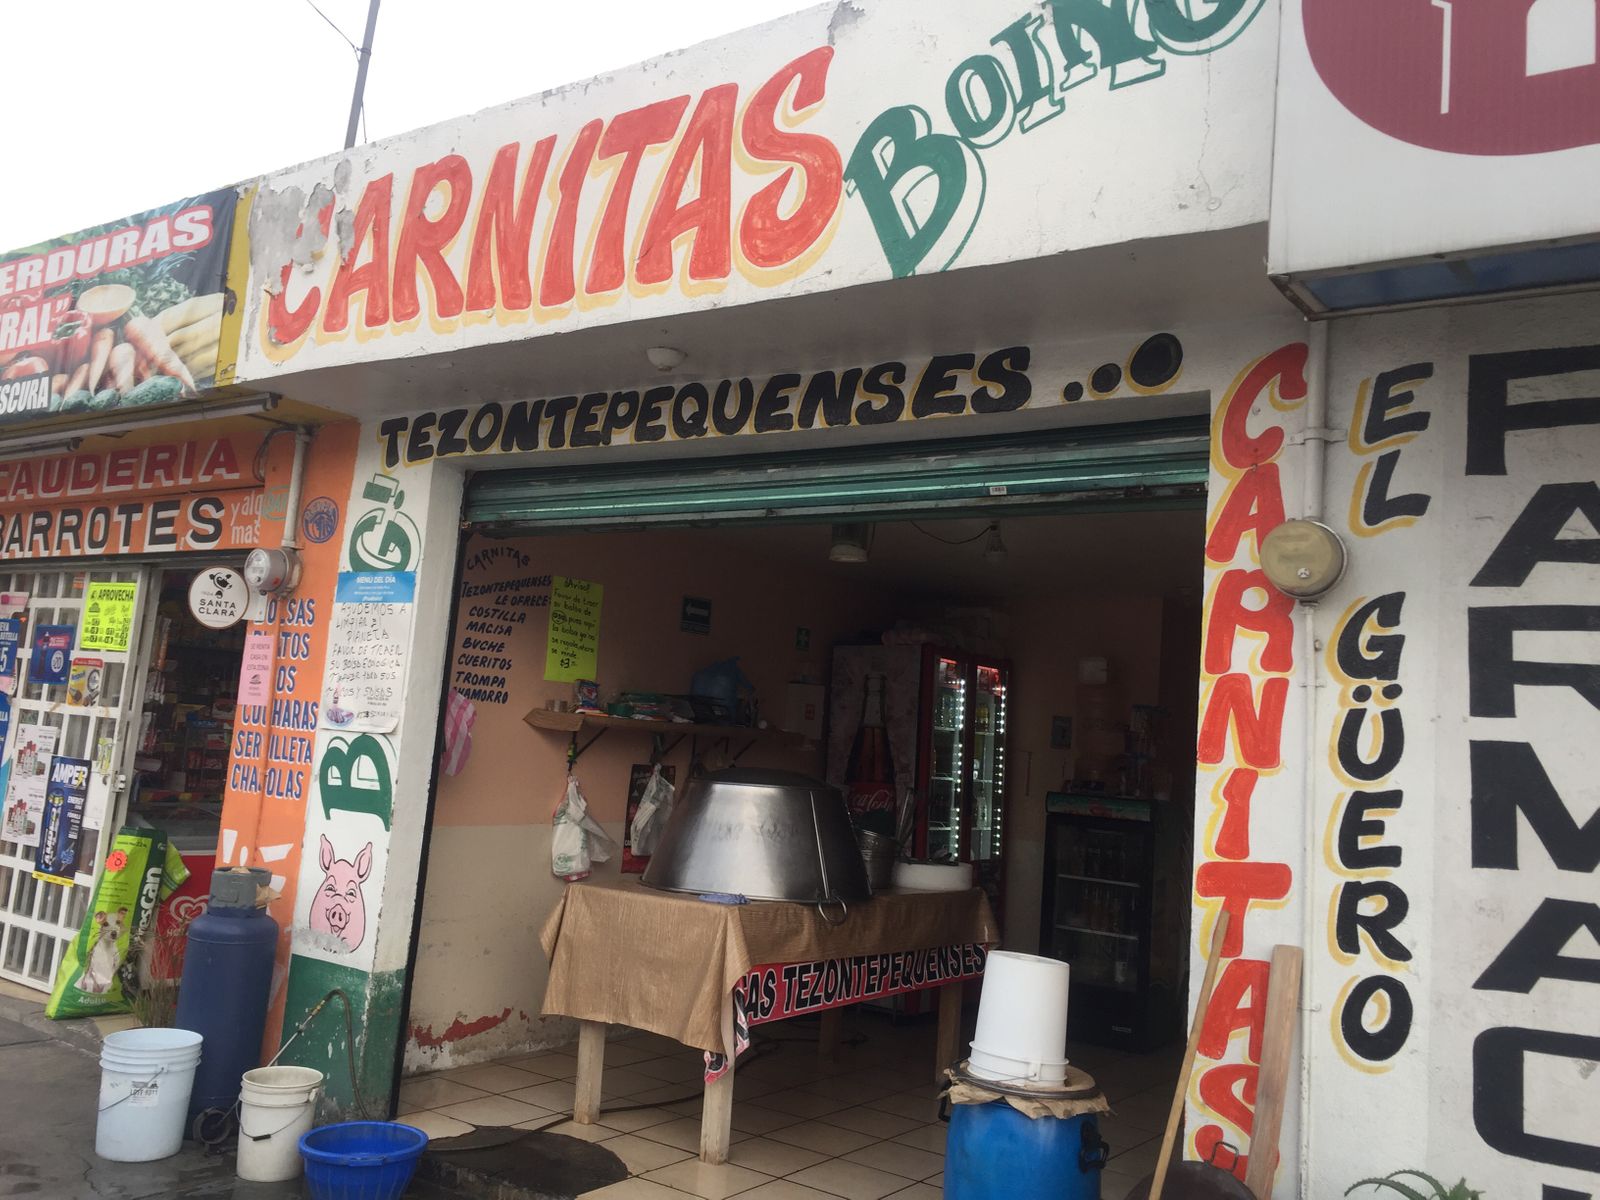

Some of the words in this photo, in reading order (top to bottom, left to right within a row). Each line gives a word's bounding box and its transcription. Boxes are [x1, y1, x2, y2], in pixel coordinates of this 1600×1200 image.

[268, 45, 843, 345] CARNITAS
[0, 376, 49, 415] SCURA
[379, 346, 1032, 468] TEZONTEPEQUENSES
[1352, 362, 1433, 532] EL
[0, 496, 225, 559] ARROTES
[467, 547, 531, 570] CARNITAS
[98, 588, 135, 603] APROVECHA
[200, 599, 236, 609] SANTA
[198, 607, 236, 617] CLARA
[469, 606, 527, 624] COSTILLA
[465, 621, 513, 637] MACISA
[462, 637, 505, 653] BUCHE
[457, 653, 512, 670] CUERITOS
[455, 671, 506, 689] TROMPA
[1187, 342, 1309, 1182] CARNITAS
[1464, 345, 1600, 1200] FARMAC
[51, 763, 88, 788] AMPER
[1330, 591, 1413, 1066] GÜERO
[782, 942, 989, 1014] TEZONTEPEQUENSES
